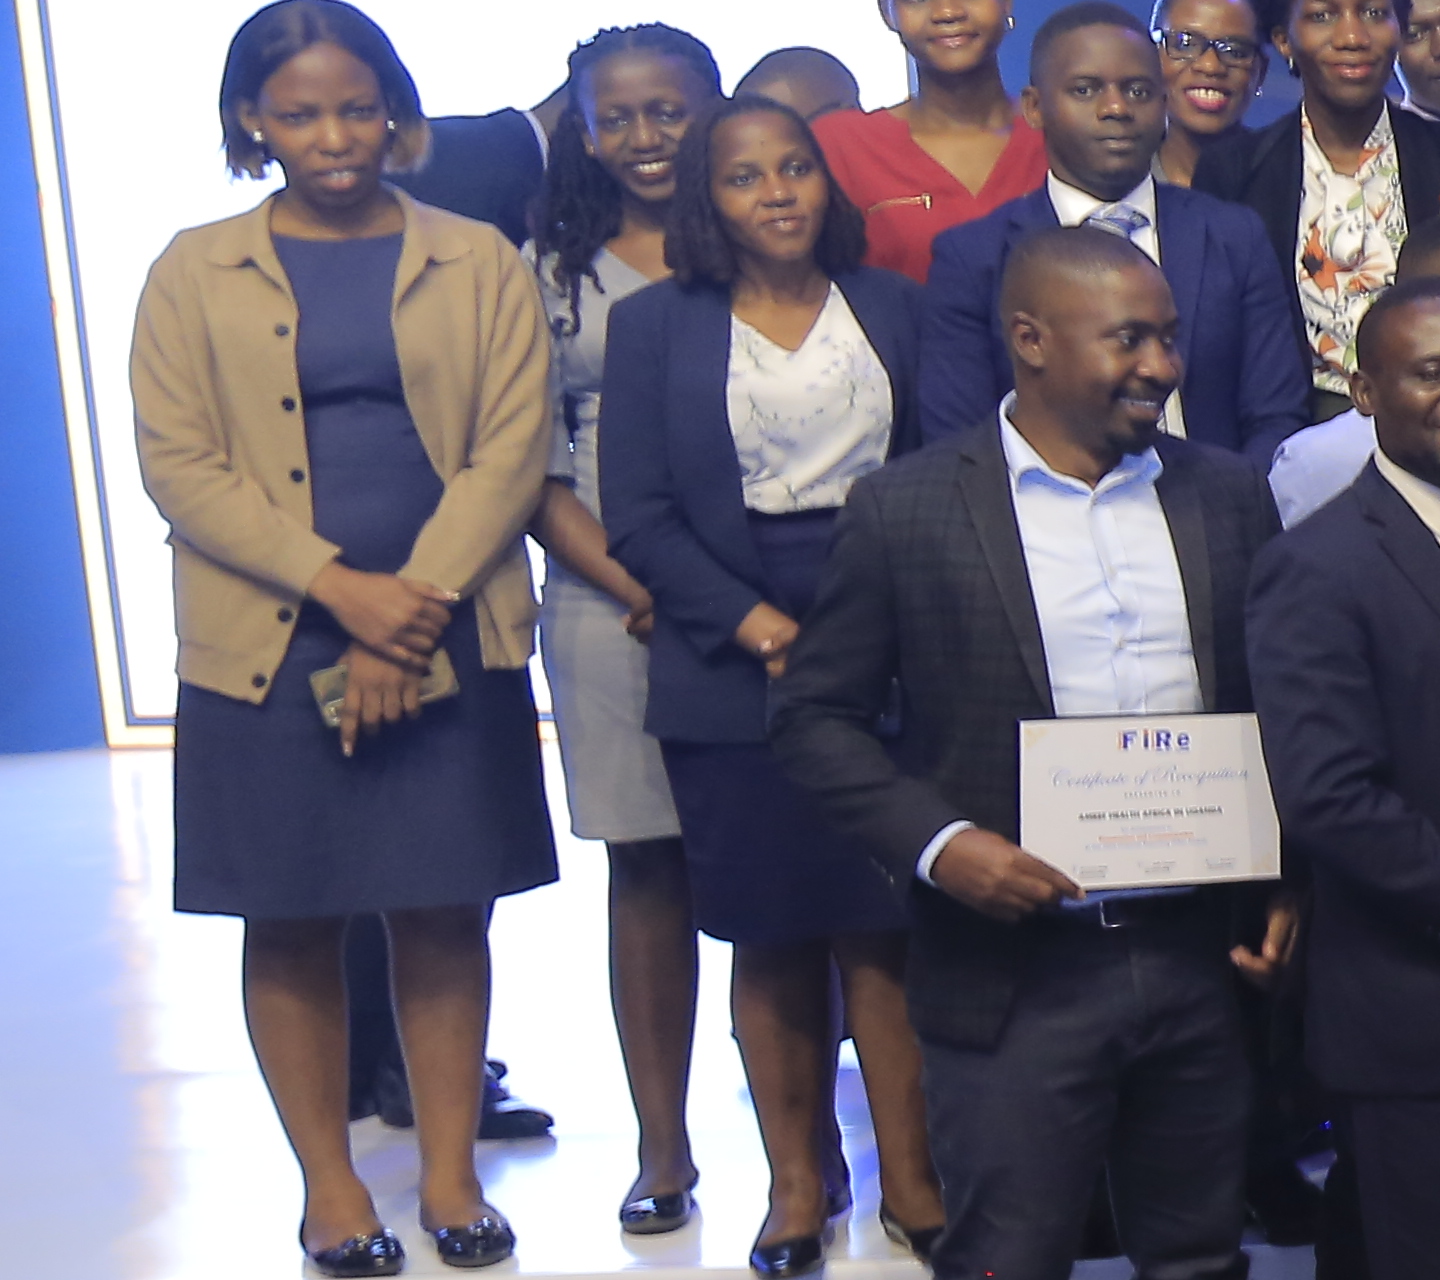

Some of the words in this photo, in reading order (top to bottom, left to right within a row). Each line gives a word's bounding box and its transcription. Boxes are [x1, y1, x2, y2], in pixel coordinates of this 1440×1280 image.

[1117, 728, 1191, 751] FiRe
[1049, 765, 1127, 788] Certificate
[1134, 770, 1151, 787] of
[1152, 762, 1250, 787] Recognition
